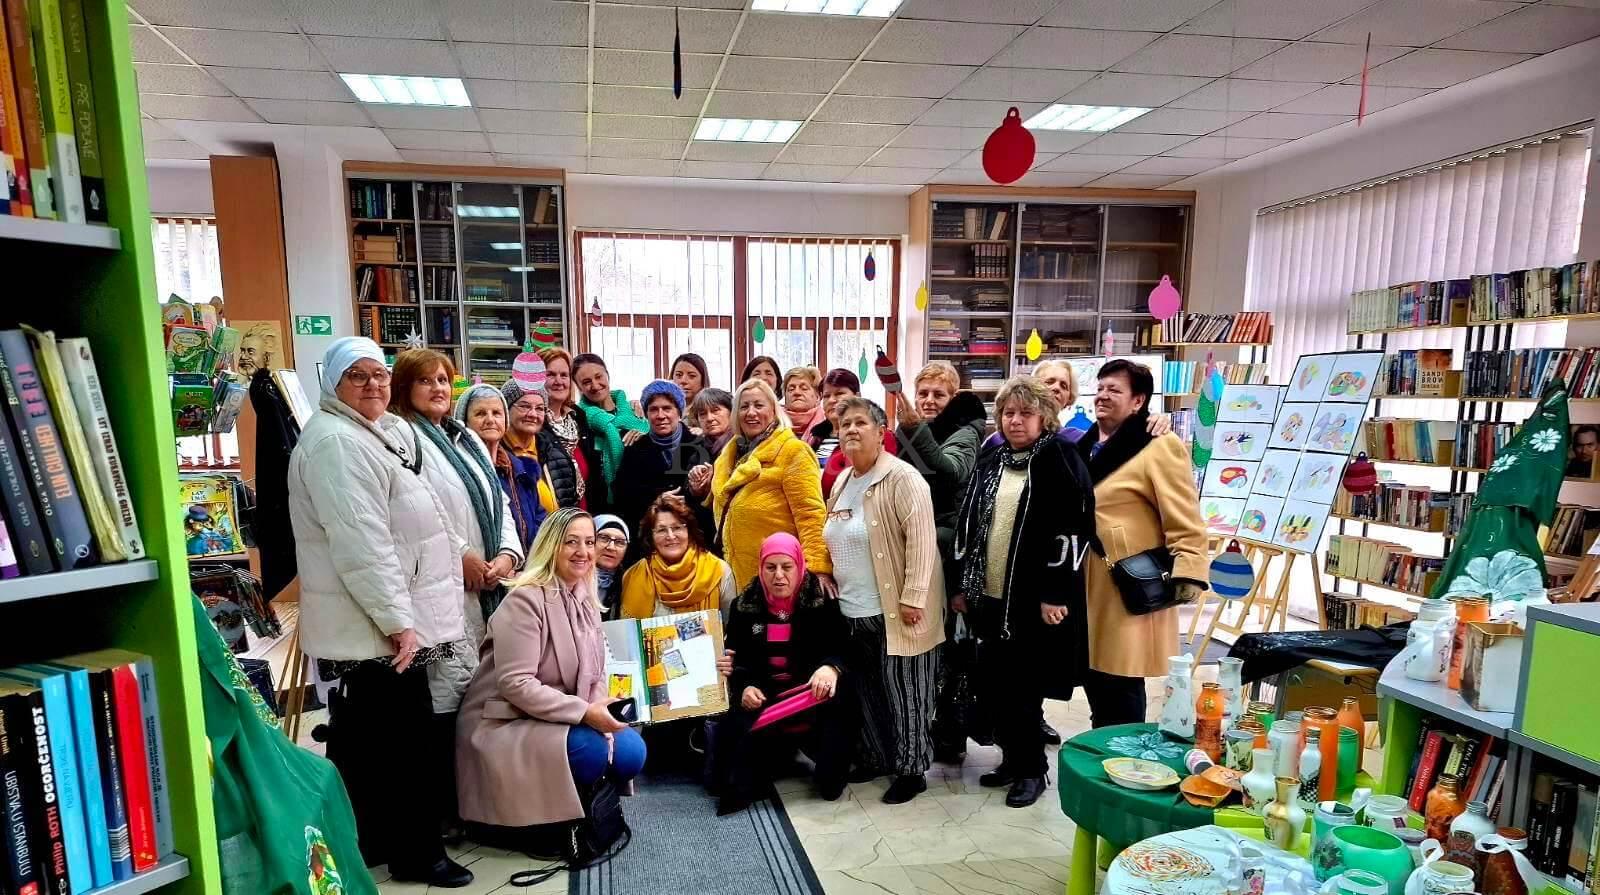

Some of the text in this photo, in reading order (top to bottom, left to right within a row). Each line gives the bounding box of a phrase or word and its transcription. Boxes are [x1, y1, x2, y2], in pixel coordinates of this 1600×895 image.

[21, 429, 53, 516] OLGA TOKARCZUK
[35, 424, 72, 499] ELIN CULLHED
[17, 501, 31, 527] OLGA
[5, 770, 21, 812] UBISTVA
[13, 822, 32, 877] ISTANBULU
[32, 707, 65, 875] Philip ROTH OGORČENOST
